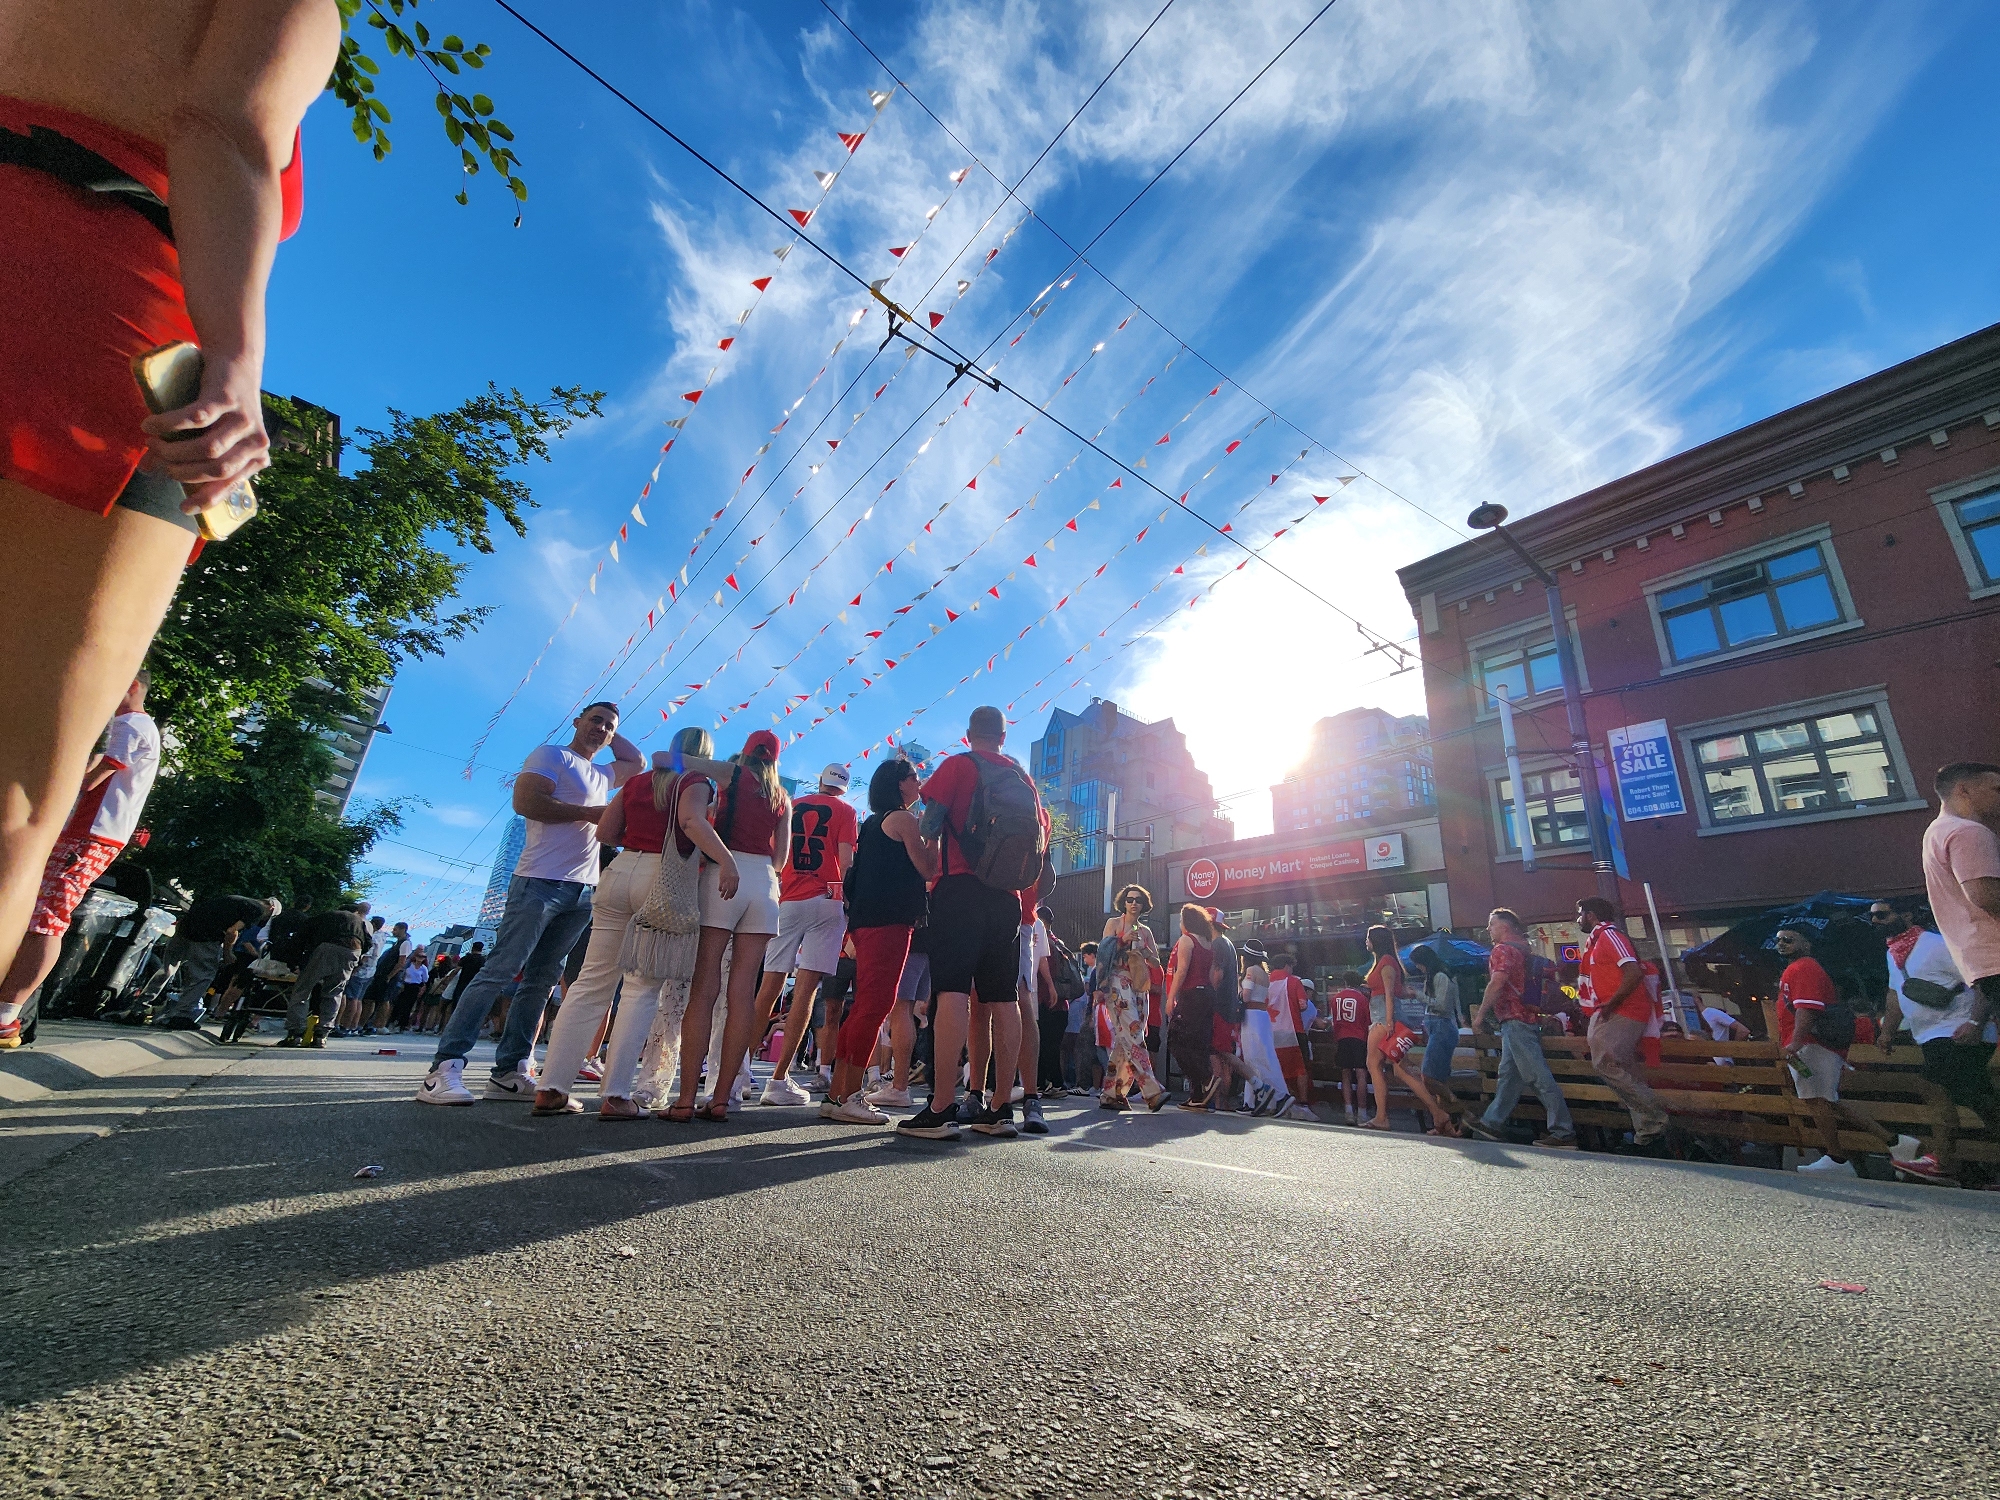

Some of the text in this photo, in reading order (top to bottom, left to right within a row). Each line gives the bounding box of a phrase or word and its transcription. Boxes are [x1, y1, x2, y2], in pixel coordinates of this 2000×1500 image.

[1623, 741, 1658, 759] FOR
[1621, 754, 1667, 775] SALE
[1627, 801, 1681, 815] 604.609.0882
[1309, 852, 1350, 863] Instant Loans
[1309, 857, 1360, 870] Cheque Cashing
[1190, 870, 1216, 881] Money
[1224, 858, 1302, 881] Money Mart
[1194, 880, 1212, 888] Mart
[1336, 997, 1357, 1023] 19
